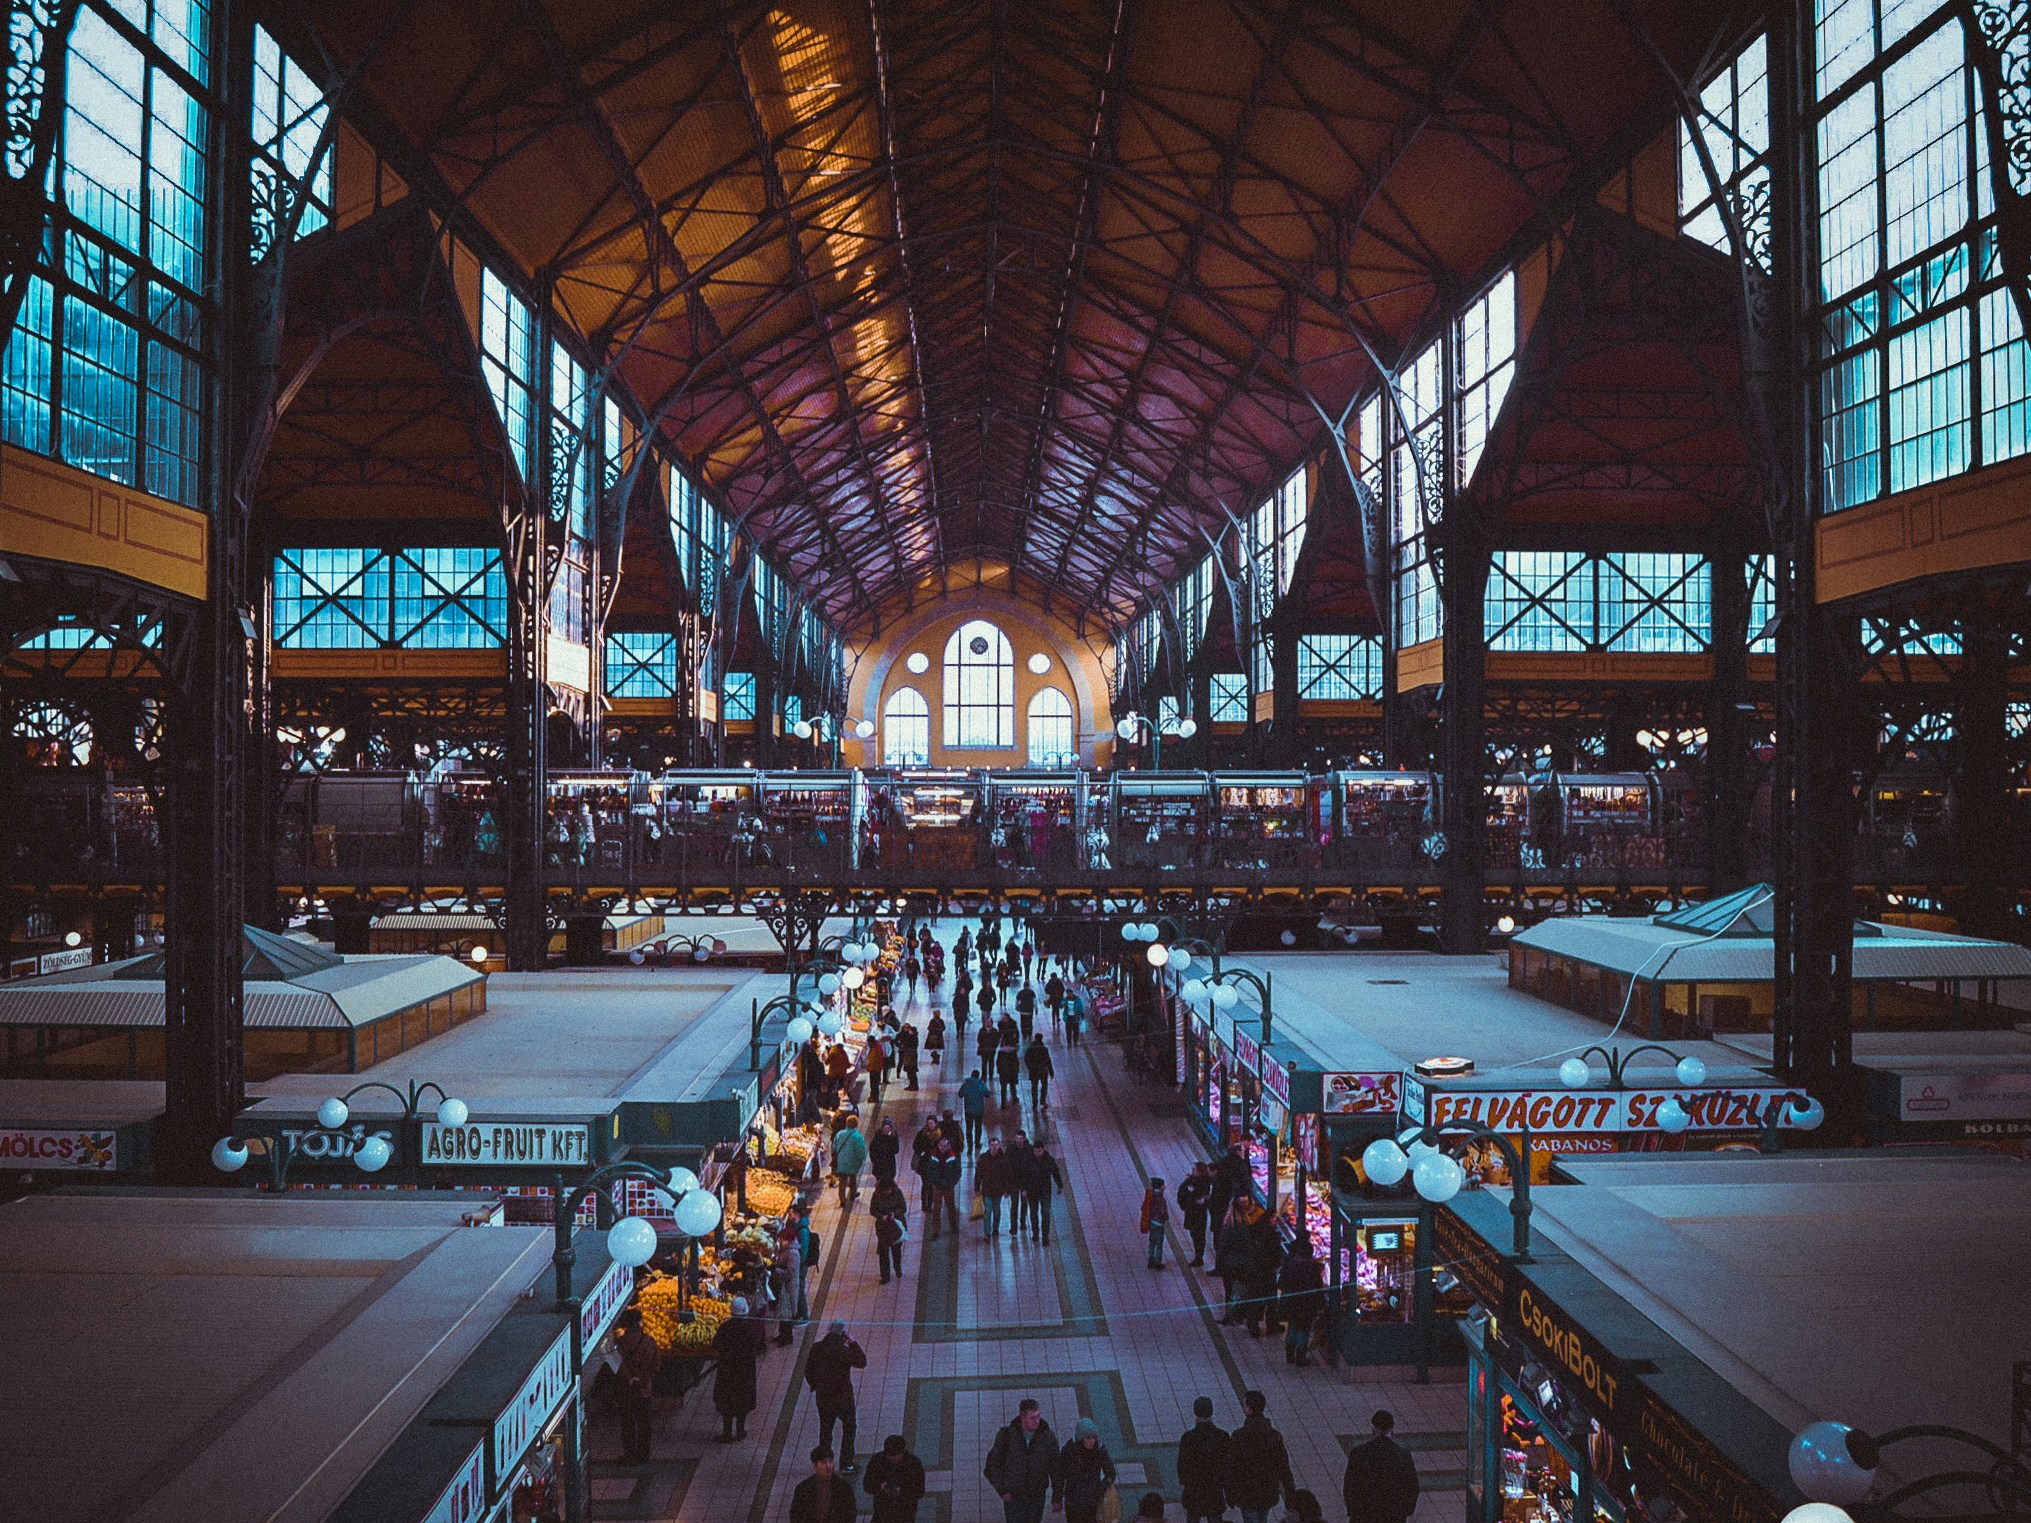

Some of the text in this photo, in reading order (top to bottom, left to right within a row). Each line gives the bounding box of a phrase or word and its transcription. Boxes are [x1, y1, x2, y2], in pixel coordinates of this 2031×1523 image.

[1434, 1092, 1616, 1130] FELVÁGOTT
[427, 1127, 588, 1162] AGRO-FRUIT KFT.
